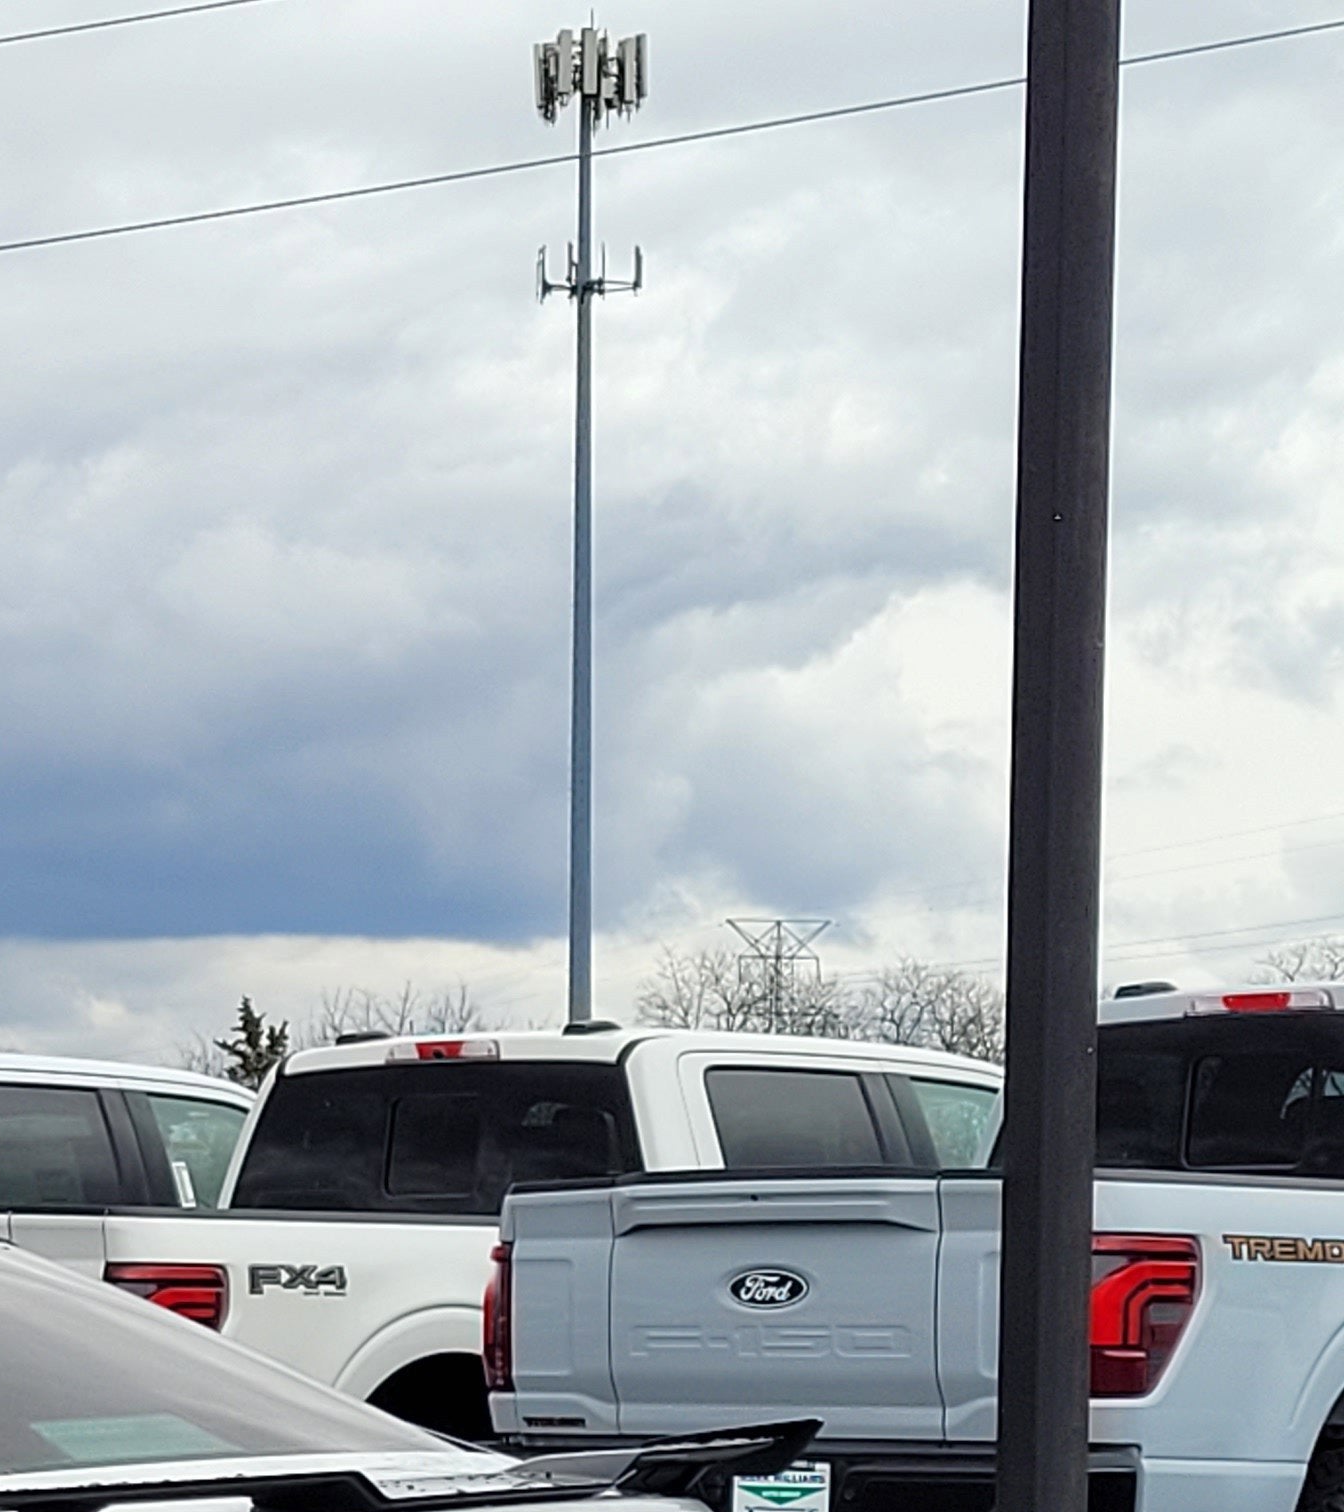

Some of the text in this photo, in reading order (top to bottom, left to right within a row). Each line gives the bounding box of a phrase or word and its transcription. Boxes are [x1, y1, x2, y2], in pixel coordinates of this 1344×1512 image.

[248, 1264, 346, 1295] FX4
[740, 1274, 791, 1301] Ford
[629, 1324, 913, 1358] F-150
